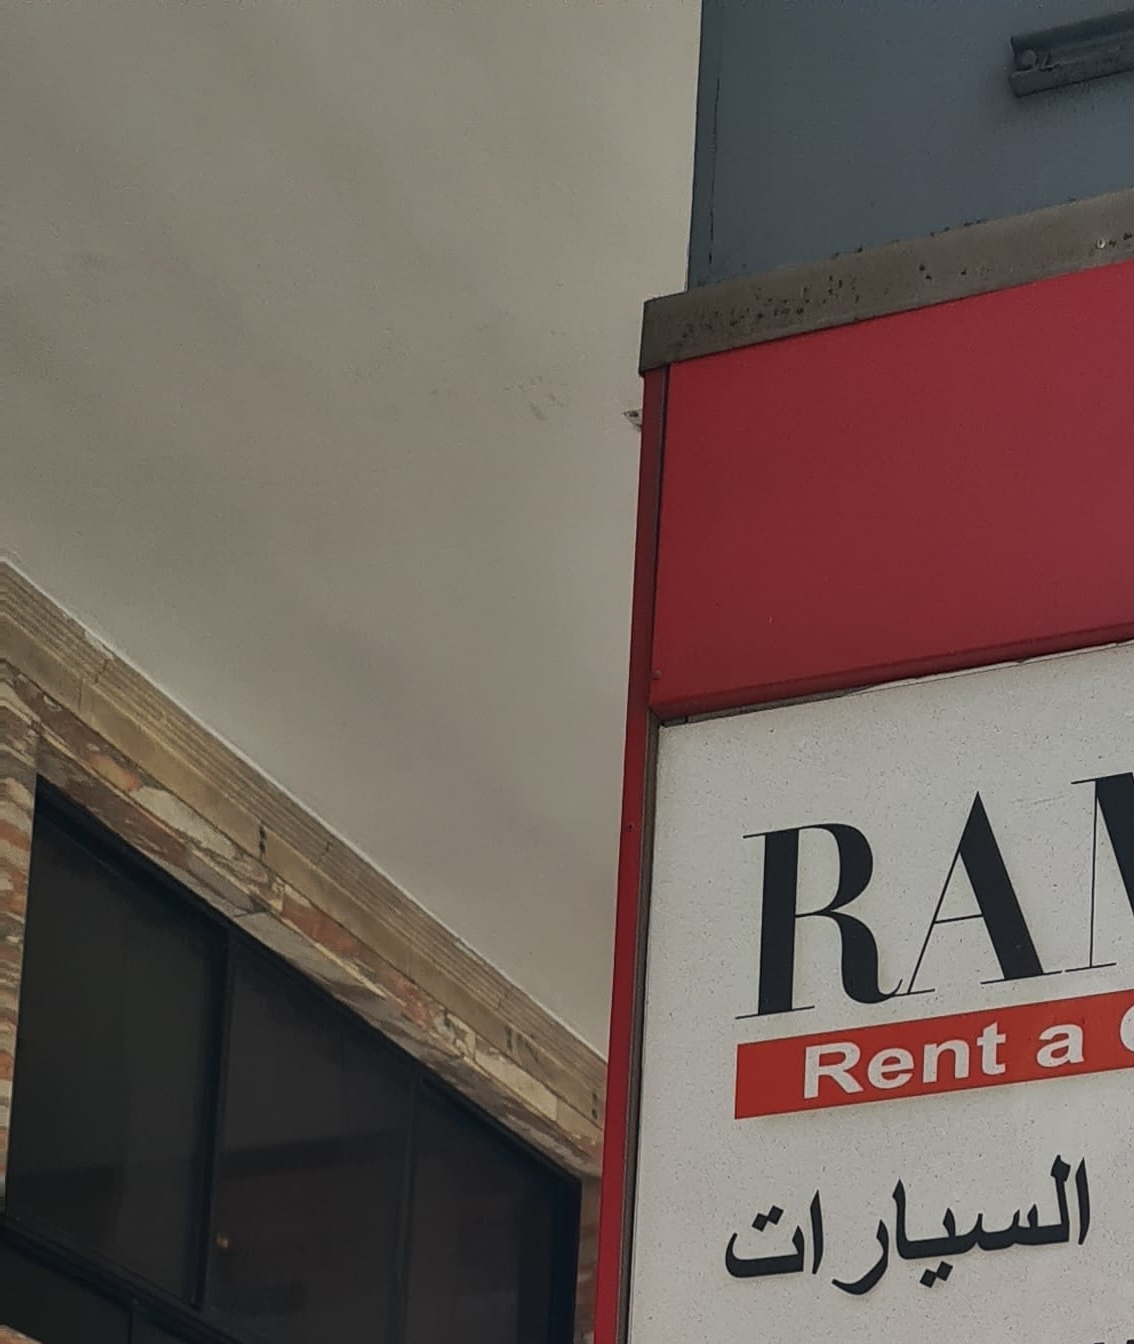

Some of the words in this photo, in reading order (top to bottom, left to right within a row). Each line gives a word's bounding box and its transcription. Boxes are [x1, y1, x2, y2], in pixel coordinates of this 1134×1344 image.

[802, 1023, 1009, 1099] Rent
[1036, 1021, 1085, 1068] a
[724, 1153, 1089, 1296] السيارات
